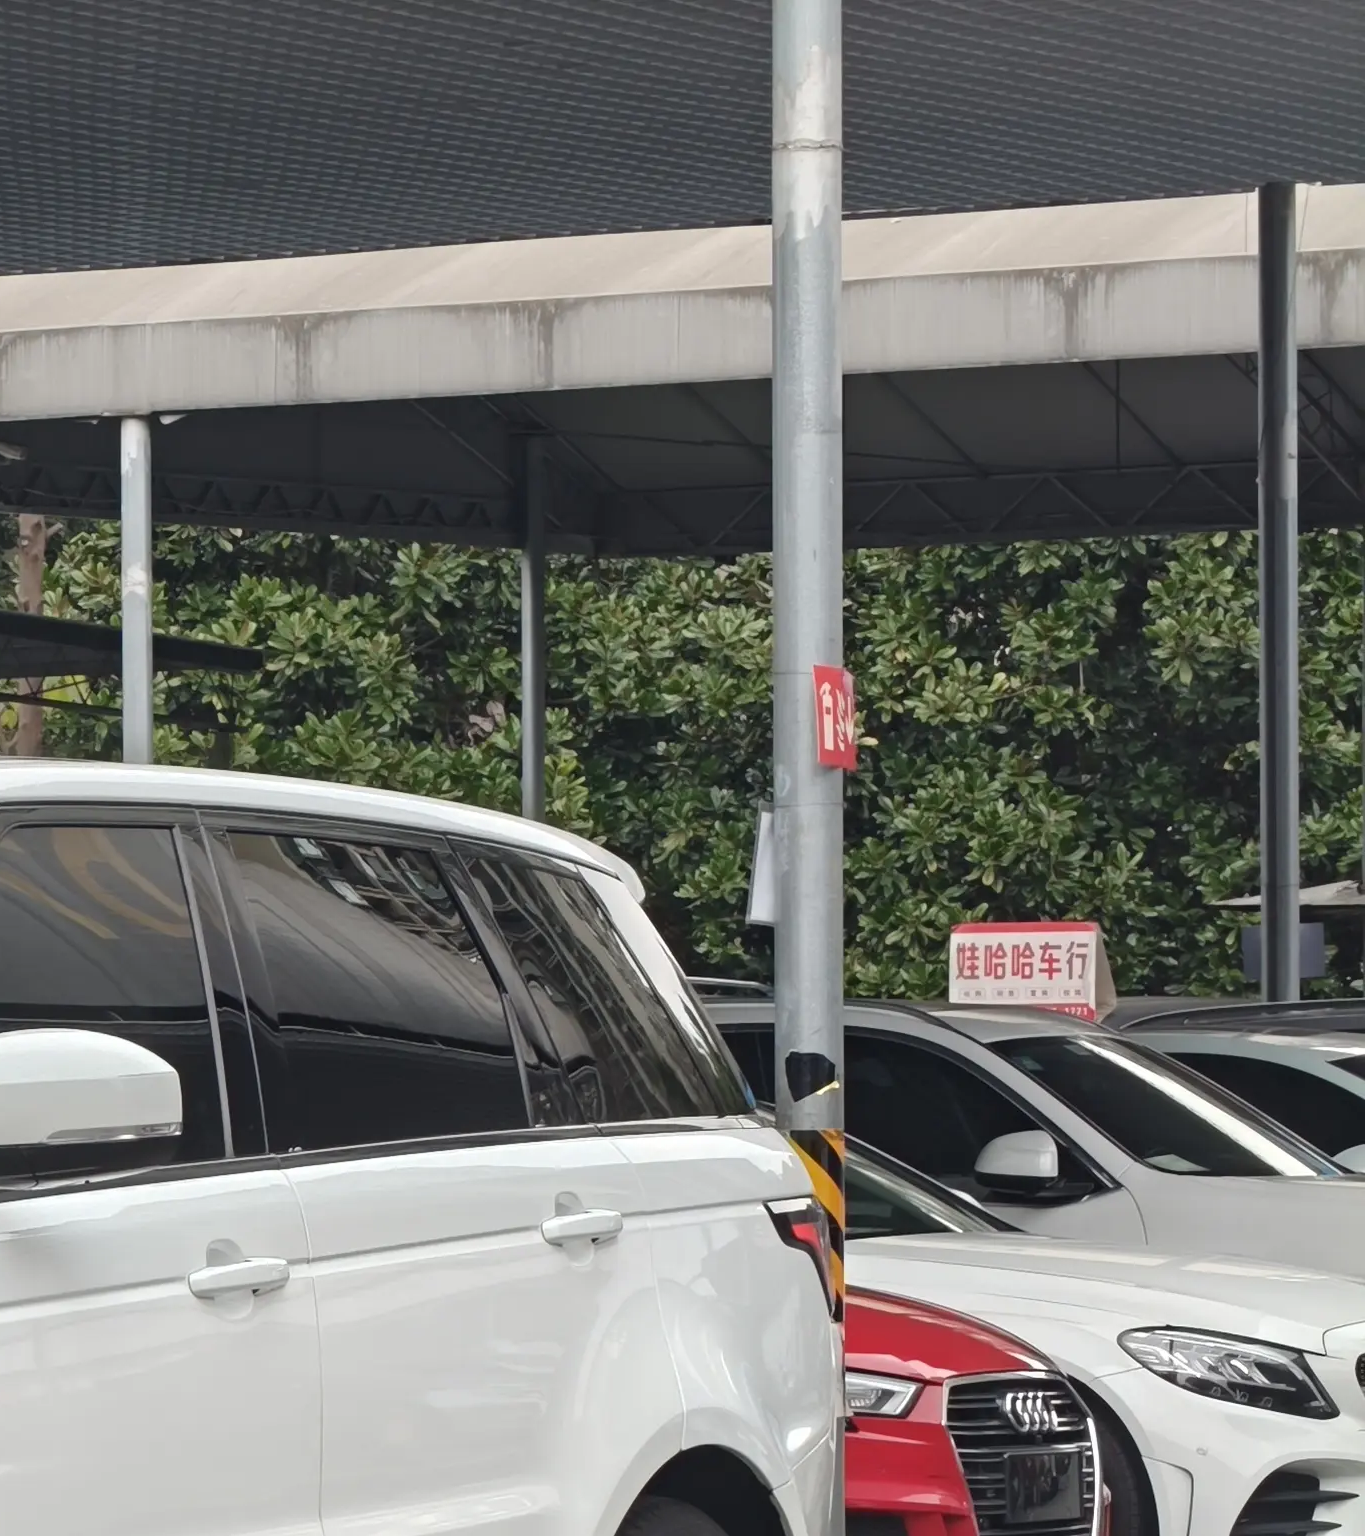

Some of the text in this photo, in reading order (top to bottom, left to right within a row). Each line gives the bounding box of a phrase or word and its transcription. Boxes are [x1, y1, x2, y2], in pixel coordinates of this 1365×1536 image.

[955, 941, 1089, 981] 娃哈哈车行
